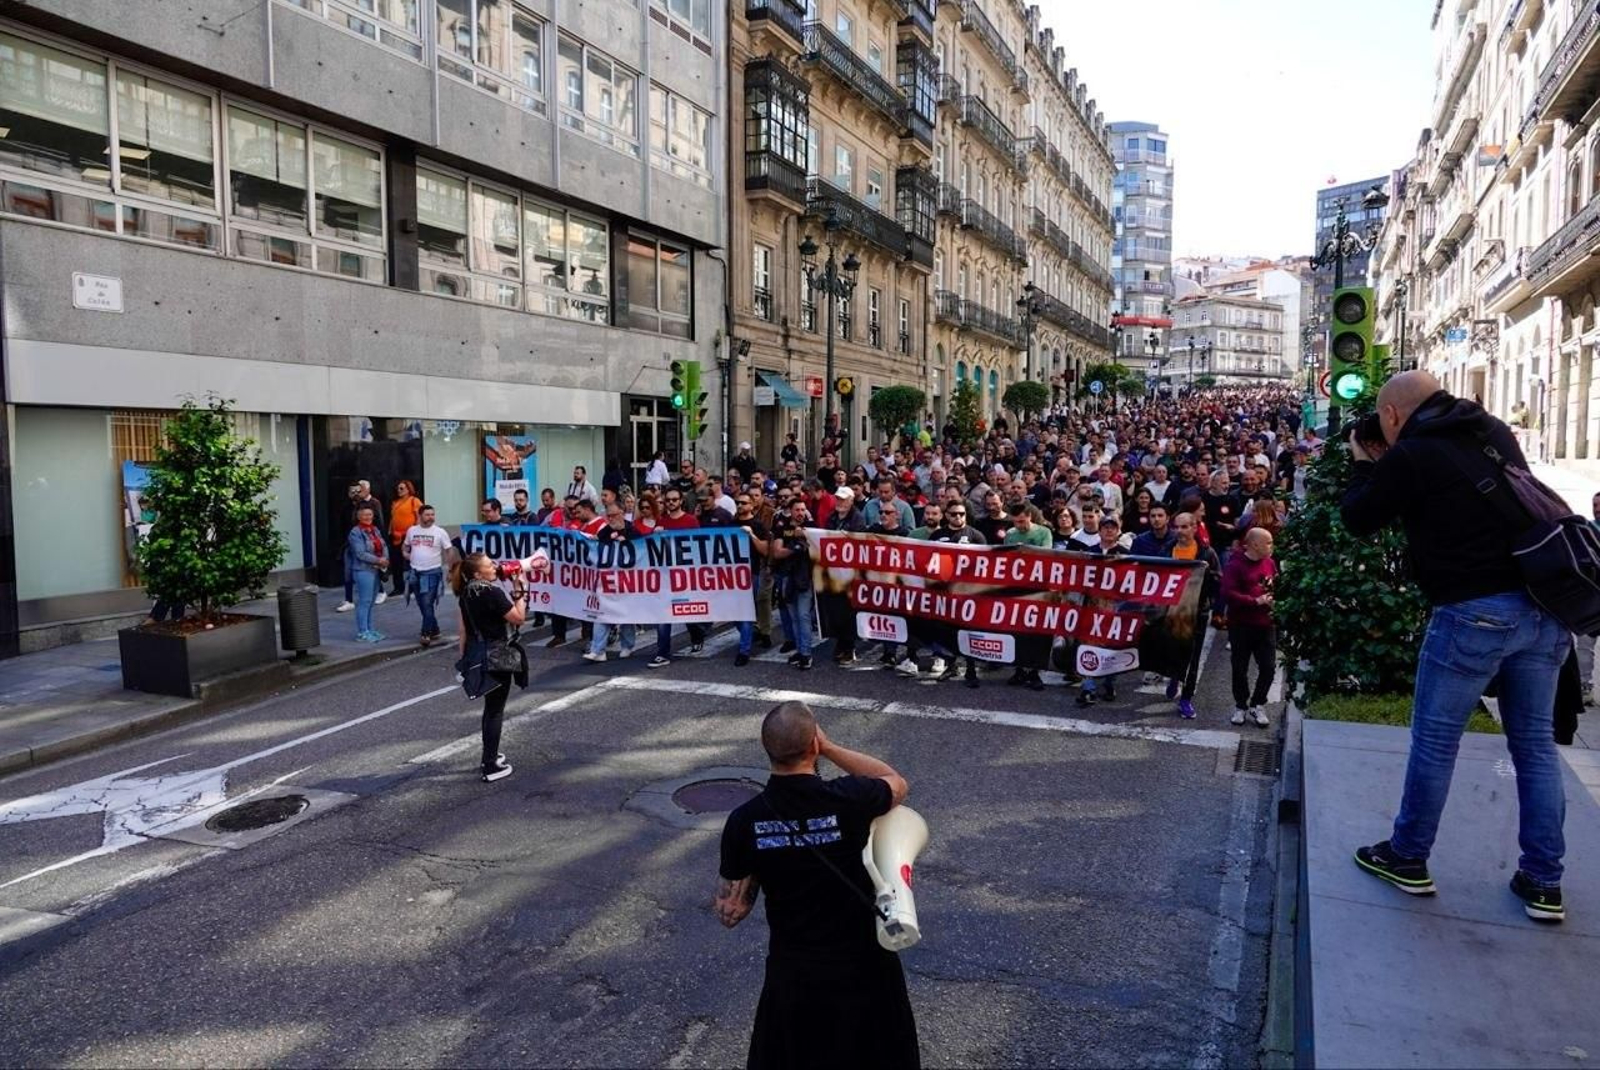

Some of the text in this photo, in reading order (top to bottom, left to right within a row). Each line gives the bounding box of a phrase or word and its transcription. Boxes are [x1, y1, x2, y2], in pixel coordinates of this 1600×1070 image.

[597, 540, 636, 568] DO
[645, 533, 750, 567] METAL
[560, 564, 661, 593] CONVENIO
[669, 565, 751, 592] DIGNO
[825, 542, 1182, 598] CONTRA A PRECARIEDADE
[673, 603, 707, 614] CCOO
[857, 584, 1138, 641] CONVENIO DIGNO XA!
[970, 639, 1002, 651] CCOO
